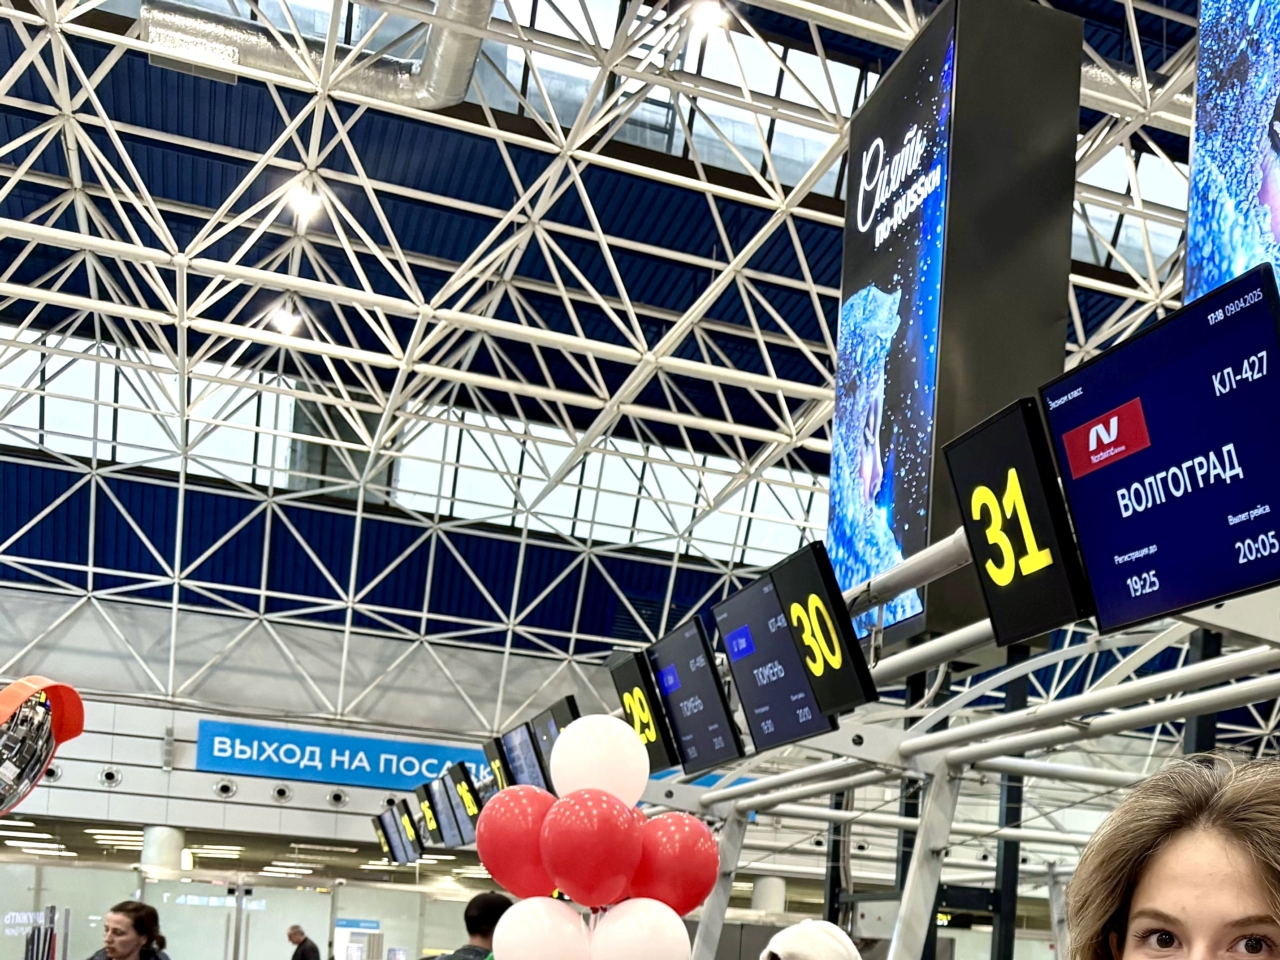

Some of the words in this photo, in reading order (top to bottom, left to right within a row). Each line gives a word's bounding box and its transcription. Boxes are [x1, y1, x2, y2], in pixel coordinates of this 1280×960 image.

[1207, 308, 1225, 326] 17:18
[1225, 288, 1263, 317] 09.04.2025
[1211, 350, 1267, 397] КЛ-427
[1116, 443, 1244, 518] ВОЛГОГРАД
[970, 467, 1054, 588] 31
[1234, 530, 1280, 565] 20:05
[1126, 570, 1160, 598] 19:25
[790, 593, 843, 677] 30
[753, 660, 785, 687] ТЮМЕНЬ
[623, 686, 657, 745] 29
[213, 736, 323, 771] ВЫХОД
[330, 748, 372, 772] НА
[379, 753, 494, 789] ПОСАДК
